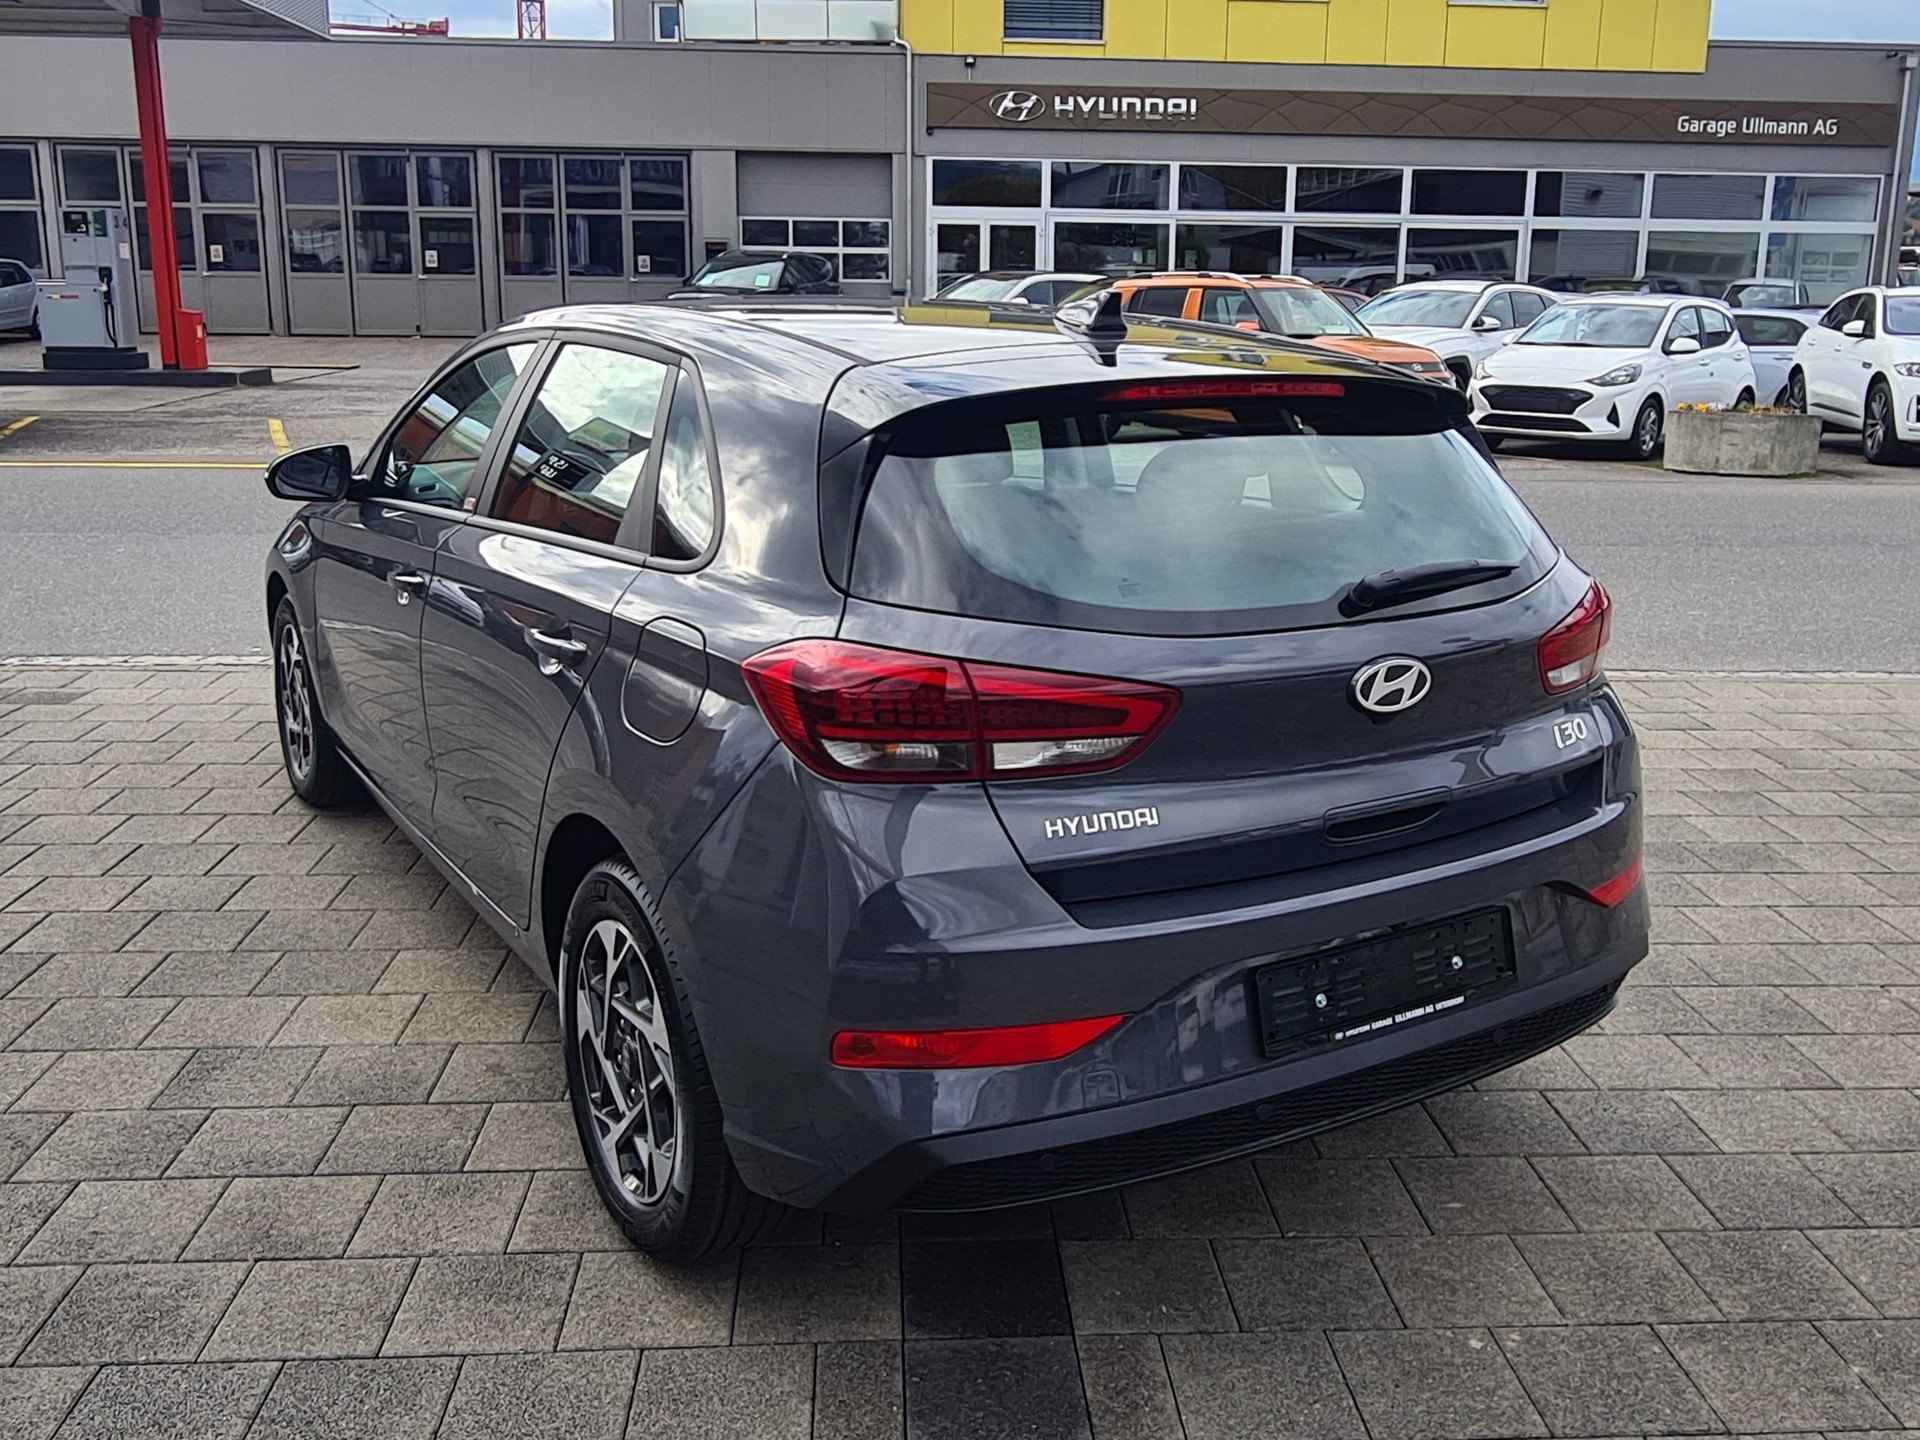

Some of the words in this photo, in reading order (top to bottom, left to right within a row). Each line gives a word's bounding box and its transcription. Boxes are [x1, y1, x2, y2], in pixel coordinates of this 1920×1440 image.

[1053, 95, 1198, 121] HYUNDAI
[1677, 115, 1737, 138] Garage
[1742, 117, 1809, 135] Ullmann
[1812, 119, 1839, 135] AG
[1044, 806, 1159, 839] HYUNDAI
